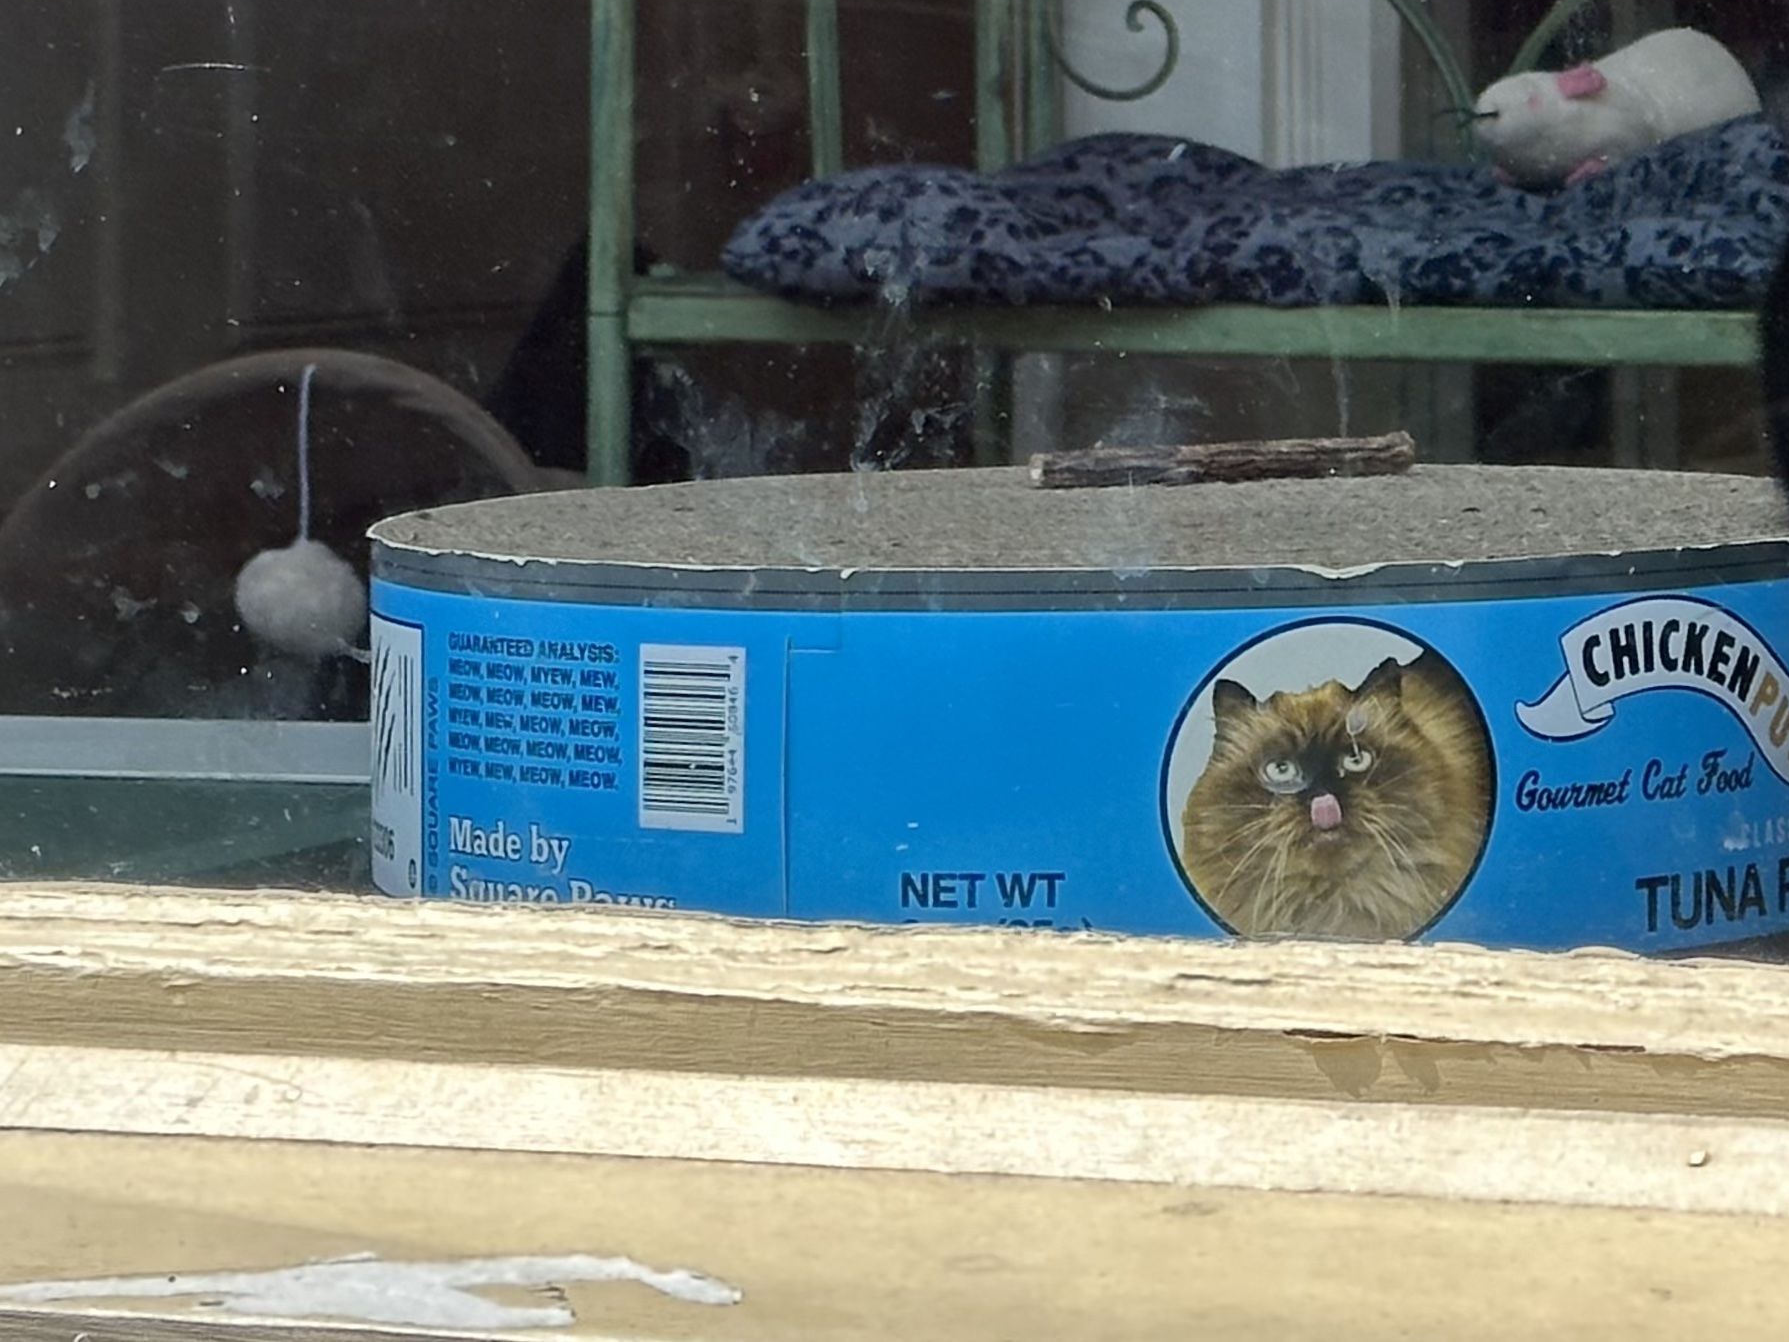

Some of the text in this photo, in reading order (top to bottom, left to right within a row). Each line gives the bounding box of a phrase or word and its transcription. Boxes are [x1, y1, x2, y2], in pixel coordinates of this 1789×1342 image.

[449, 632, 620, 664] GUARANTEED ANALYSIS:
[486, 662, 527, 685] MEOW,
[531, 666, 577, 689] MYEW,
[428, 676, 439, 750] PAWS
[531, 691, 578, 714] MEOW,
[520, 714, 566, 738] MEOW,
[569, 718, 619, 742] MEOW,
[526, 739, 571, 763] MEOW,
[520, 765, 566, 789] MEOW,
[1516, 748, 1755, 812] Gourmet Cat Food
[428, 756, 439, 868] SQUARE
[450, 816, 522, 861] Made
[530, 823, 569, 875] by
[901, 872, 1066, 908] NET WT
[1635, 863, 1767, 932] TUNA
